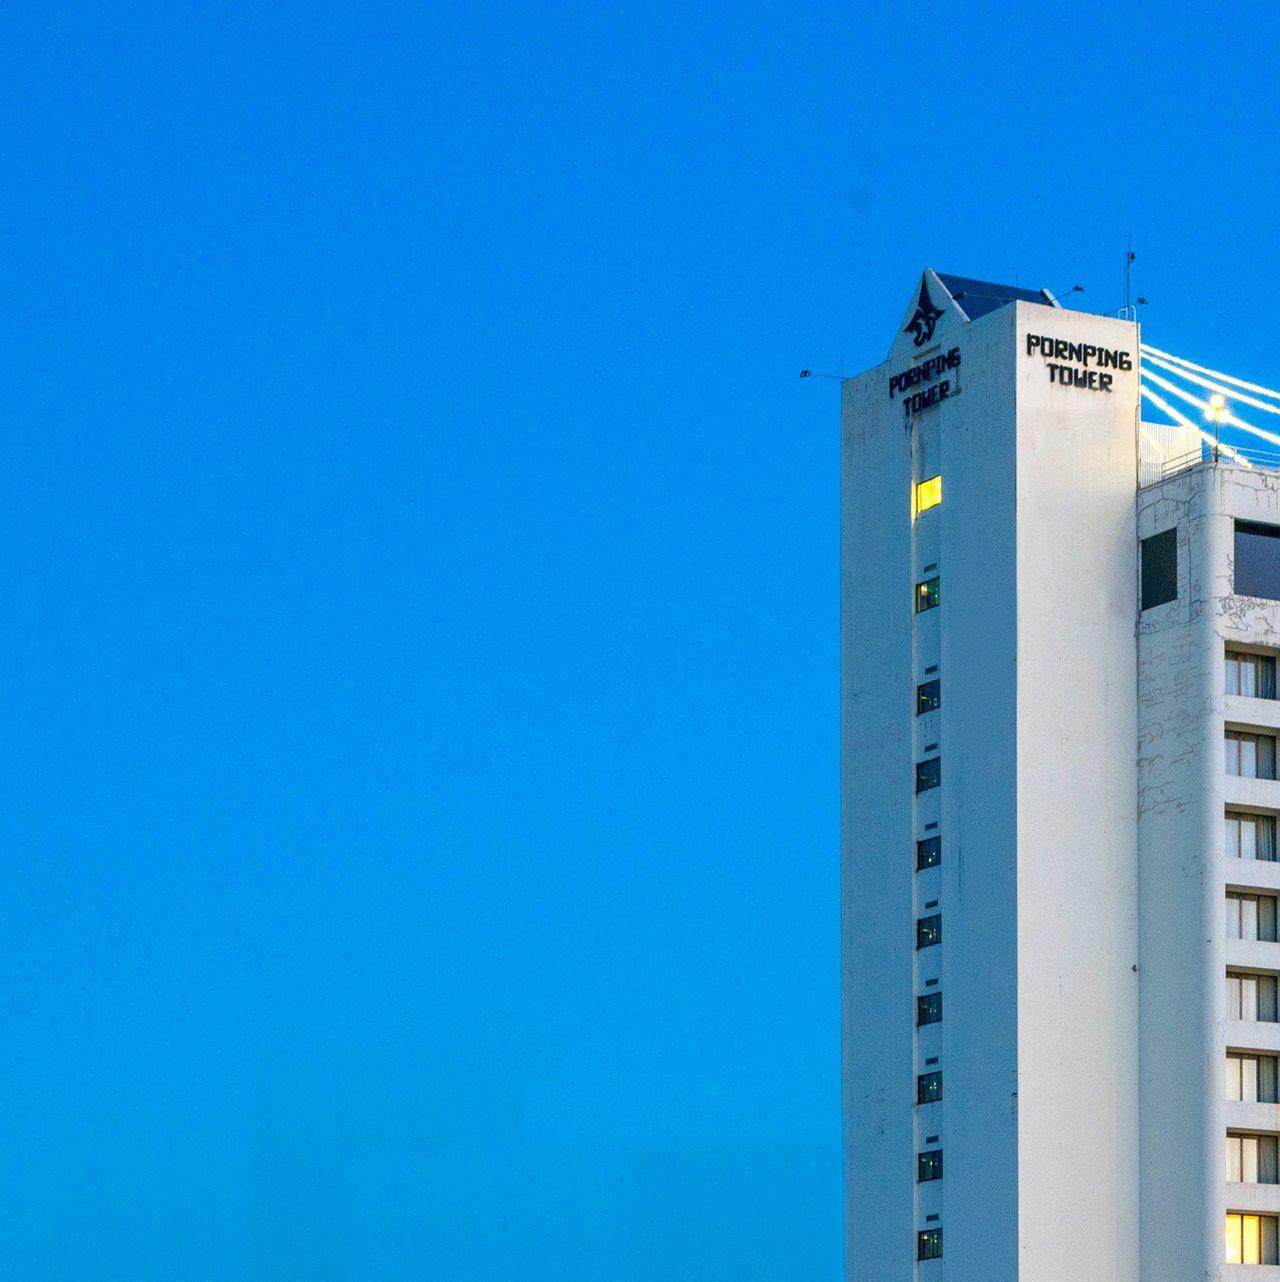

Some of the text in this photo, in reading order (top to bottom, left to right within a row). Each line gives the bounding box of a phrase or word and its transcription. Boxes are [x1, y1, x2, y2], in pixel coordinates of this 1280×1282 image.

[1026, 333, 1132, 371] PORNPING
[889, 347, 961, 399] PORNPING
[1047, 363, 1113, 393] TOWER
[903, 380, 950, 417] TOWER
